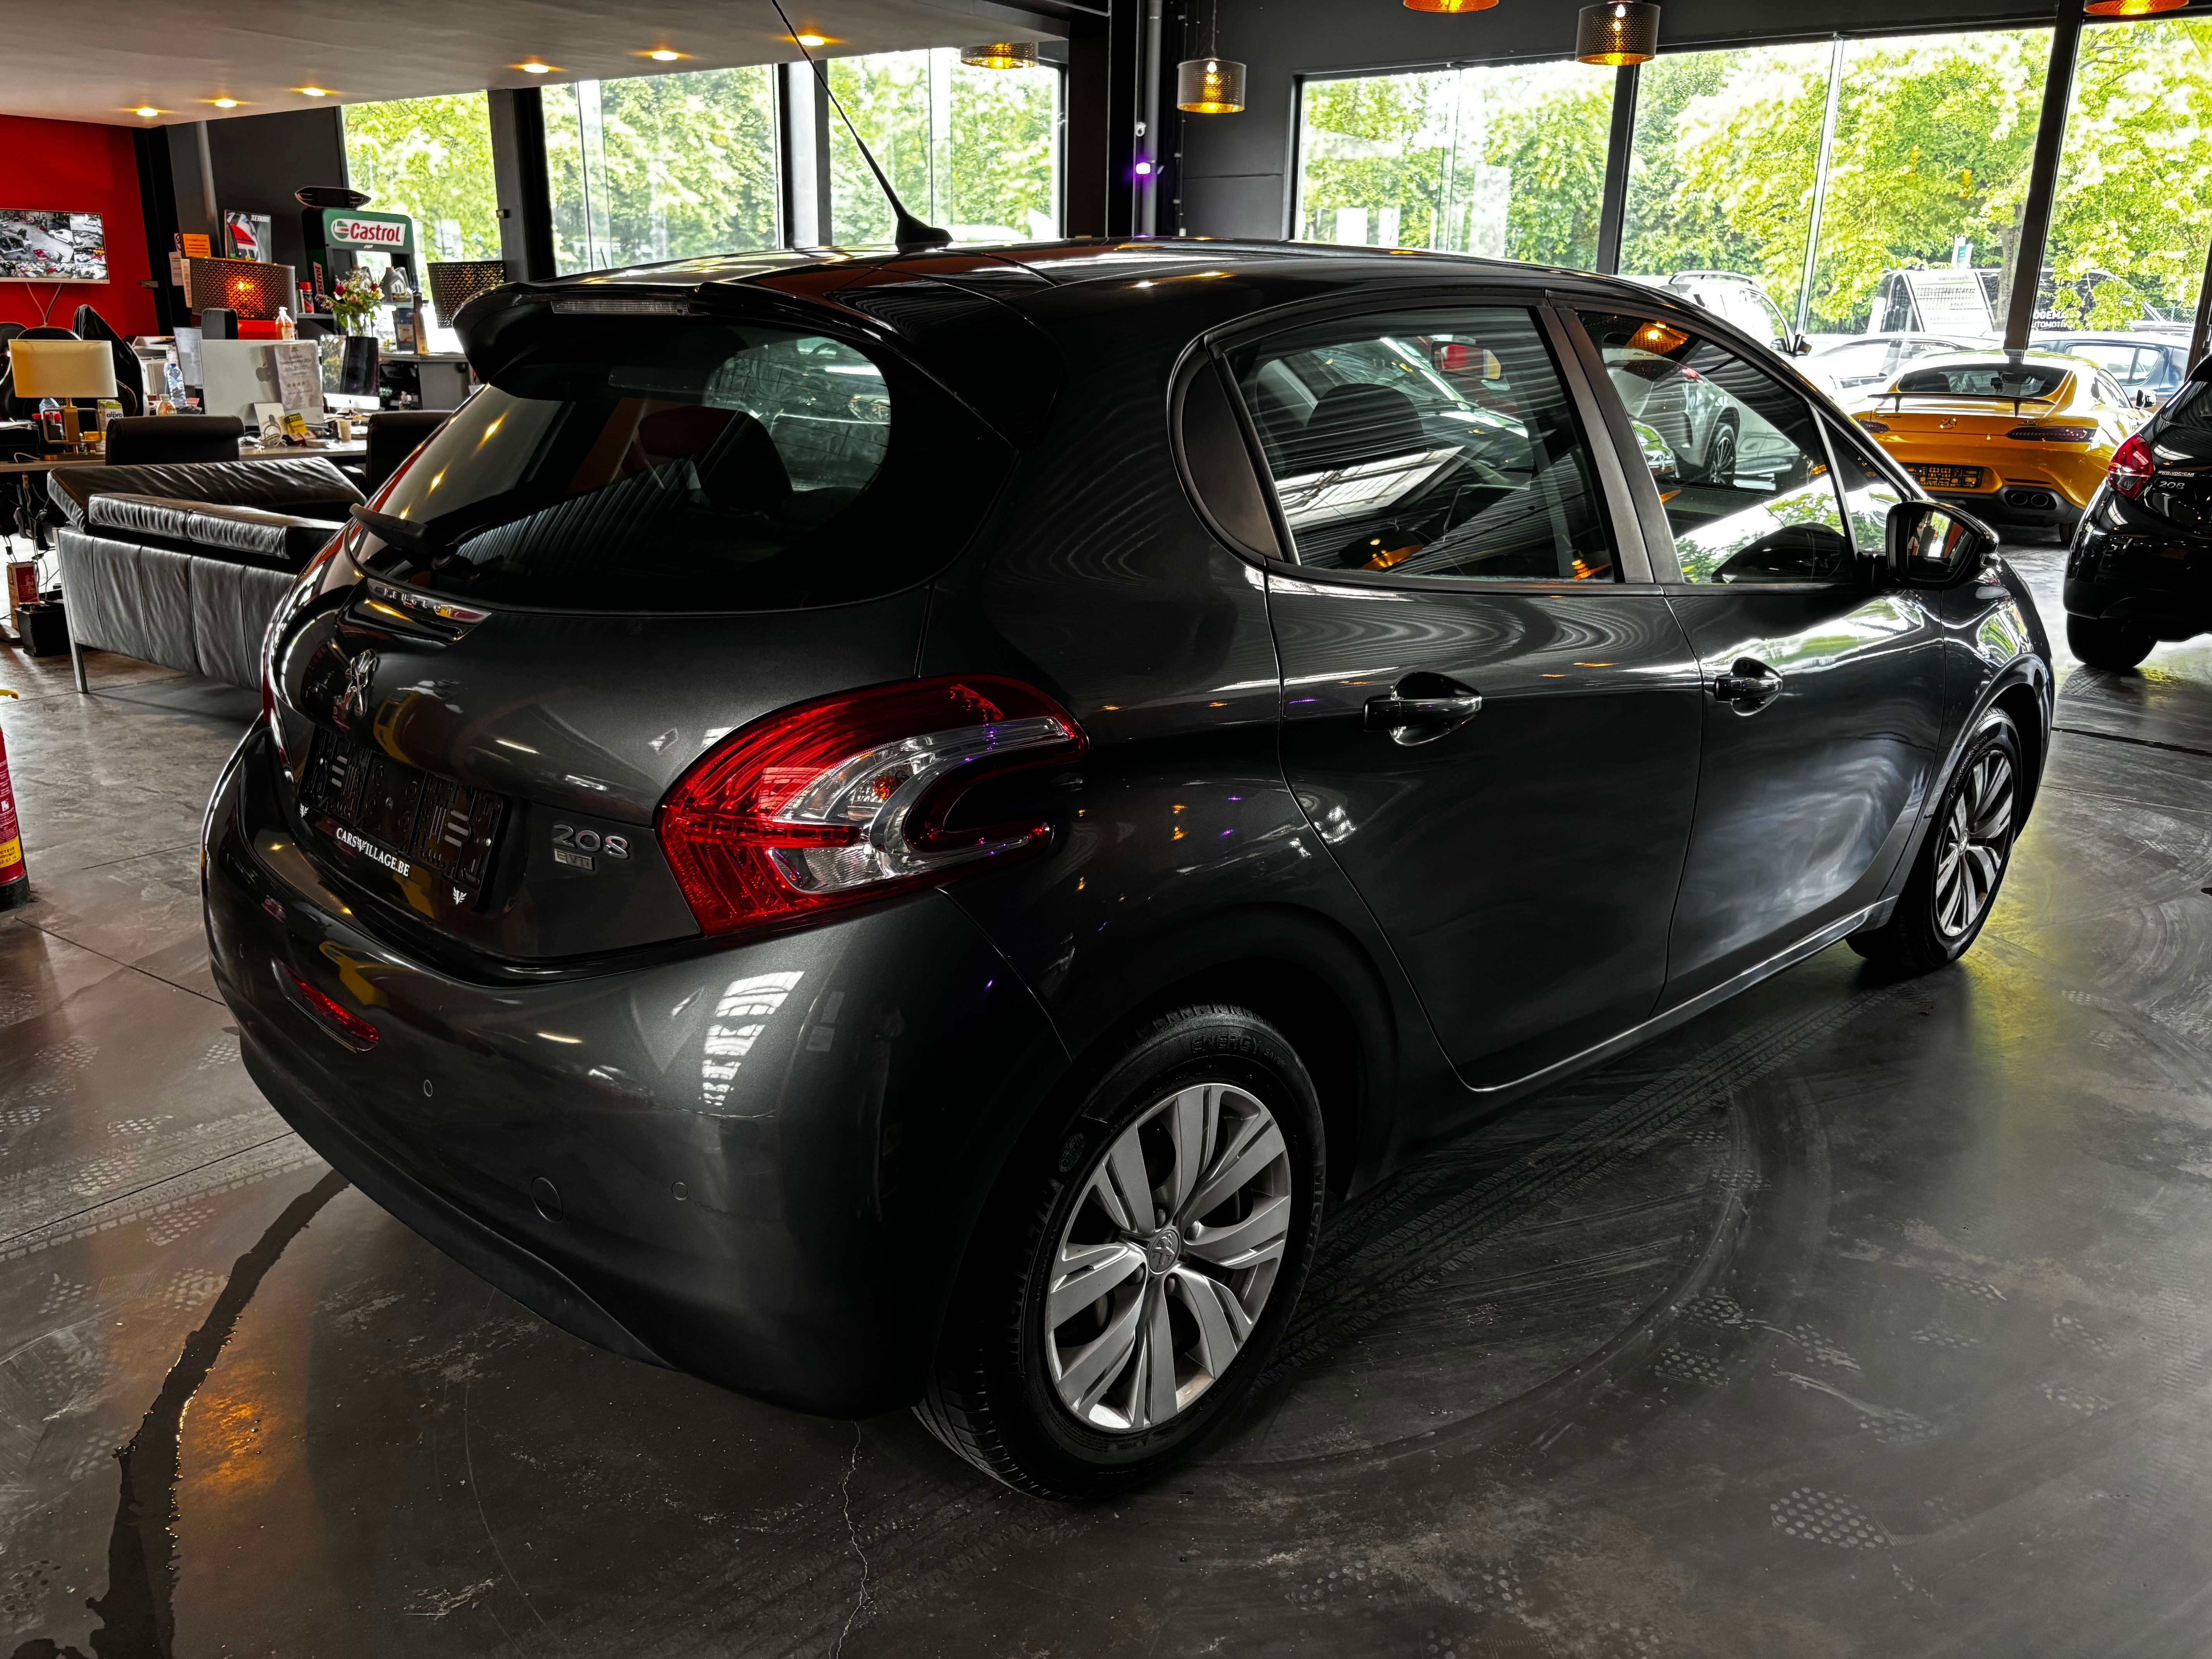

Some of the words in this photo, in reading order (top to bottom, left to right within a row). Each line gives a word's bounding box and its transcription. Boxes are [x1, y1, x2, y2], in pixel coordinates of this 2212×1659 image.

[350, 223, 400, 242] Castrol
[2159, 481, 2185, 489] 208
[336, 827, 410, 877] CARSVILLAGE.BE
[553, 824, 628, 859] 208
